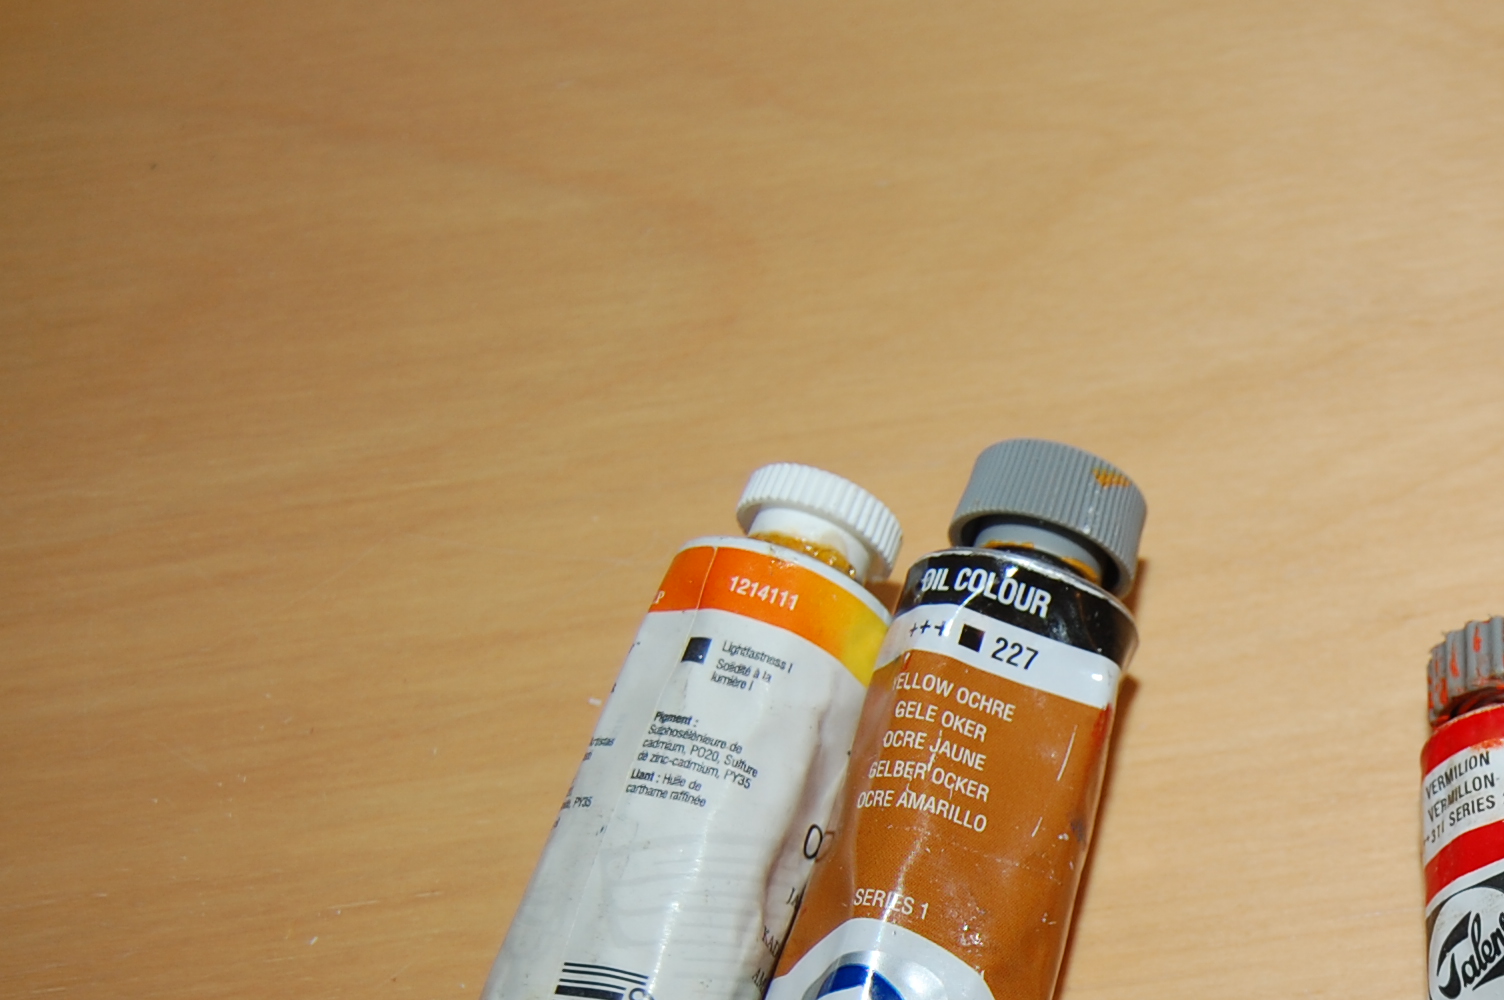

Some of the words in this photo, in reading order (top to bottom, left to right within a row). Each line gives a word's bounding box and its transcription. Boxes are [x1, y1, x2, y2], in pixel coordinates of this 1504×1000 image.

[729, 575, 799, 611] 1214111
[921, 567, 949, 592] OIL
[953, 567, 1052, 619] COLOUR
[721, 639, 787, 671] Lightfastness
[991, 636, 1039, 671] 227
[892, 672, 955, 698] YELLOW
[956, 686, 1017, 723] OCHRE
[895, 700, 937, 723] GELE
[941, 711, 988, 742] OKER
[730, 741, 743, 754] de
[883, 730, 925, 750] OCRE
[930, 732, 987, 772] JAUNE
[688, 780, 702, 791] de
[723, 769, 752, 790] PY35
[868, 760, 928, 781] GELBER
[932, 767, 991, 802] OCKER
[1425, 751, 1491, 800] VERMILION
[856, 790, 894, 809] OCRE
[896, 791, 988, 833] AMARILLO
[1449, 794, 1496, 828] SERIES
[853, 888, 915, 916] SERIES
[920, 902, 930, 920] 1
